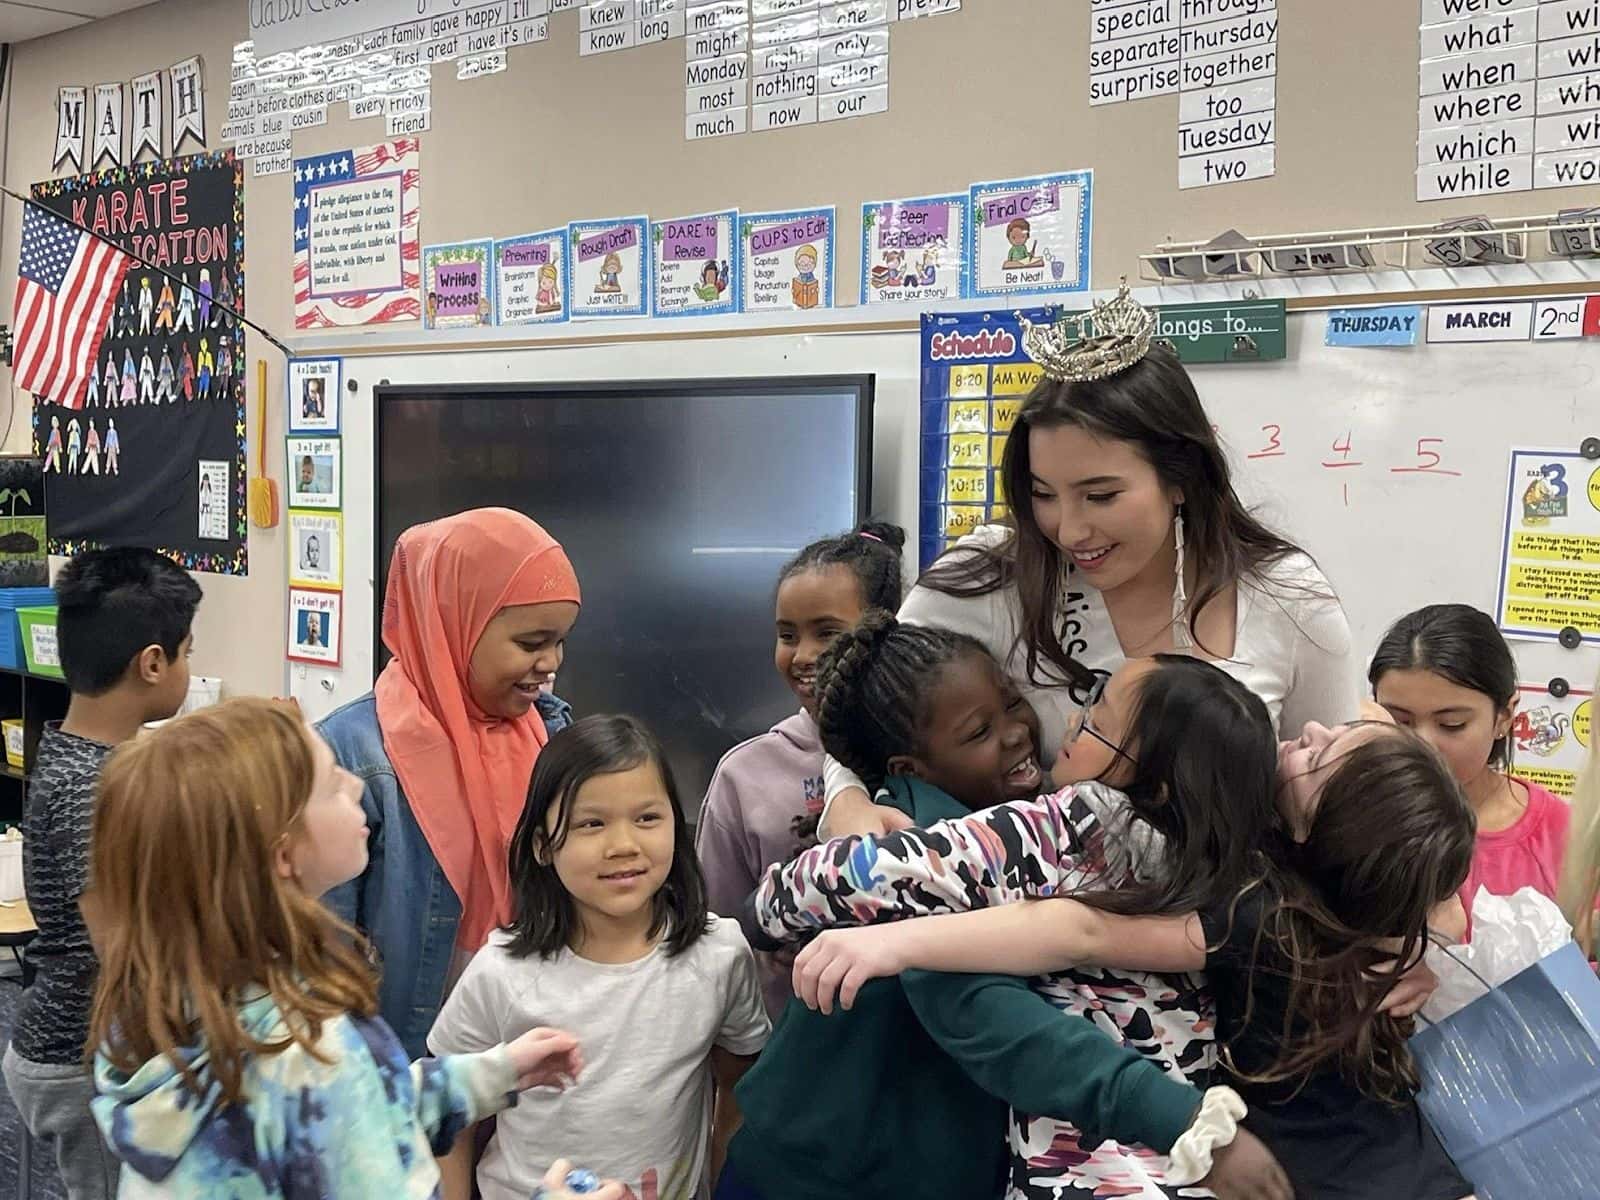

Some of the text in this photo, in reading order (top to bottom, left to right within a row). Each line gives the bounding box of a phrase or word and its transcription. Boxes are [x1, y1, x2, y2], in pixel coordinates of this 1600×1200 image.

[466, 6, 501, 30] happy
[590, 6, 625, 25] knew
[1097, 0, 1170, 40] special
[392, 25, 425, 43] family
[433, 15, 459, 36] gave
[501, 26, 518, 44] it's
[640, 21, 669, 40] long
[1444, 17, 1514, 51] what
[468, 35, 495, 50] have
[591, 32, 625, 49] know
[696, 31, 738, 57] might
[1180, 19, 1278, 52] Thursday
[395, 48, 419, 65] first
[428, 38, 458, 59] great
[1090, 34, 1179, 71] separate
[687, 60, 746, 85] Monday
[1183, 52, 1275, 87] together
[1442, 62, 1515, 91] when
[232, 82, 256, 101] again
[756, 73, 815, 97] nothing
[1090, 67, 1179, 101] surprise
[61, 73, 198, 139] MATH
[257, 96, 288, 114] before
[289, 90, 324, 109] clothes
[355, 98, 385, 116] every
[699, 88, 735, 109] most
[837, 95, 867, 114] our
[1206, 95, 1242, 117] too
[1434, 92, 1522, 122] where
[229, 102, 254, 119] about
[292, 110, 322, 127] cousin
[769, 108, 801, 125] now
[221, 121, 255, 139] animals
[263, 119, 282, 133] blue
[392, 113, 424, 133] friend
[696, 115, 734, 136] much
[1179, 119, 1271, 151] Tuesday
[238, 142, 253, 156] are
[254, 137, 292, 154] because
[1436, 129, 1516, 162] which
[255, 157, 291, 174] brother
[1204, 160, 1246, 182] two
[1438, 163, 1510, 193] while
[73, 178, 189, 236] KARATE
[314, 192, 318, 207] I
[372, 191, 380, 199] the
[383, 188, 393, 198] flag
[321, 213, 329, 221] the
[366, 207, 372, 215] of
[374, 204, 394, 214] America
[900, 210, 928, 224] Peer
[988, 200, 1018, 220] Final
[332, 227, 340, 236] the
[375, 220, 391, 231] which
[668, 223, 717, 239] DARE to
[793, 220, 825, 239] to Edit
[581, 229, 632, 256] Rough Draft
[674, 245, 705, 258] Revise
[505, 249, 547, 262] Prewriting
[440, 271, 477, 287] Writing
[1006, 271, 1043, 284] Be Neat!
[880, 286, 948, 302] Share your story!
[1224, 310, 1263, 333] to...
[1331, 314, 1415, 333] THURSDAY
[1446, 311, 1512, 329] MARCH
[1539, 303, 1580, 336] 2nd
[931, 328, 1016, 361] Schedule
[955, 373, 983, 387] 8:20
[993, 372, 1014, 385] AM
[1262, 424, 1281, 453] 3
[1333, 431, 1352, 459] 4
[953, 444, 981, 457] 9:15
[1417, 439, 1444, 468] 5
[952, 478, 985, 492] 10:15
[1541, 463, 1568, 497] 3
[1537, 536, 1560, 546] things
[1560, 546, 1583, 555] things
[1524, 567, 1541, 575] stay
[1543, 568, 1571, 576] focused
[1516, 581, 1561, 590] distractions
[1545, 591, 1557, 599] get
[1531, 771, 1561, 779] problem
